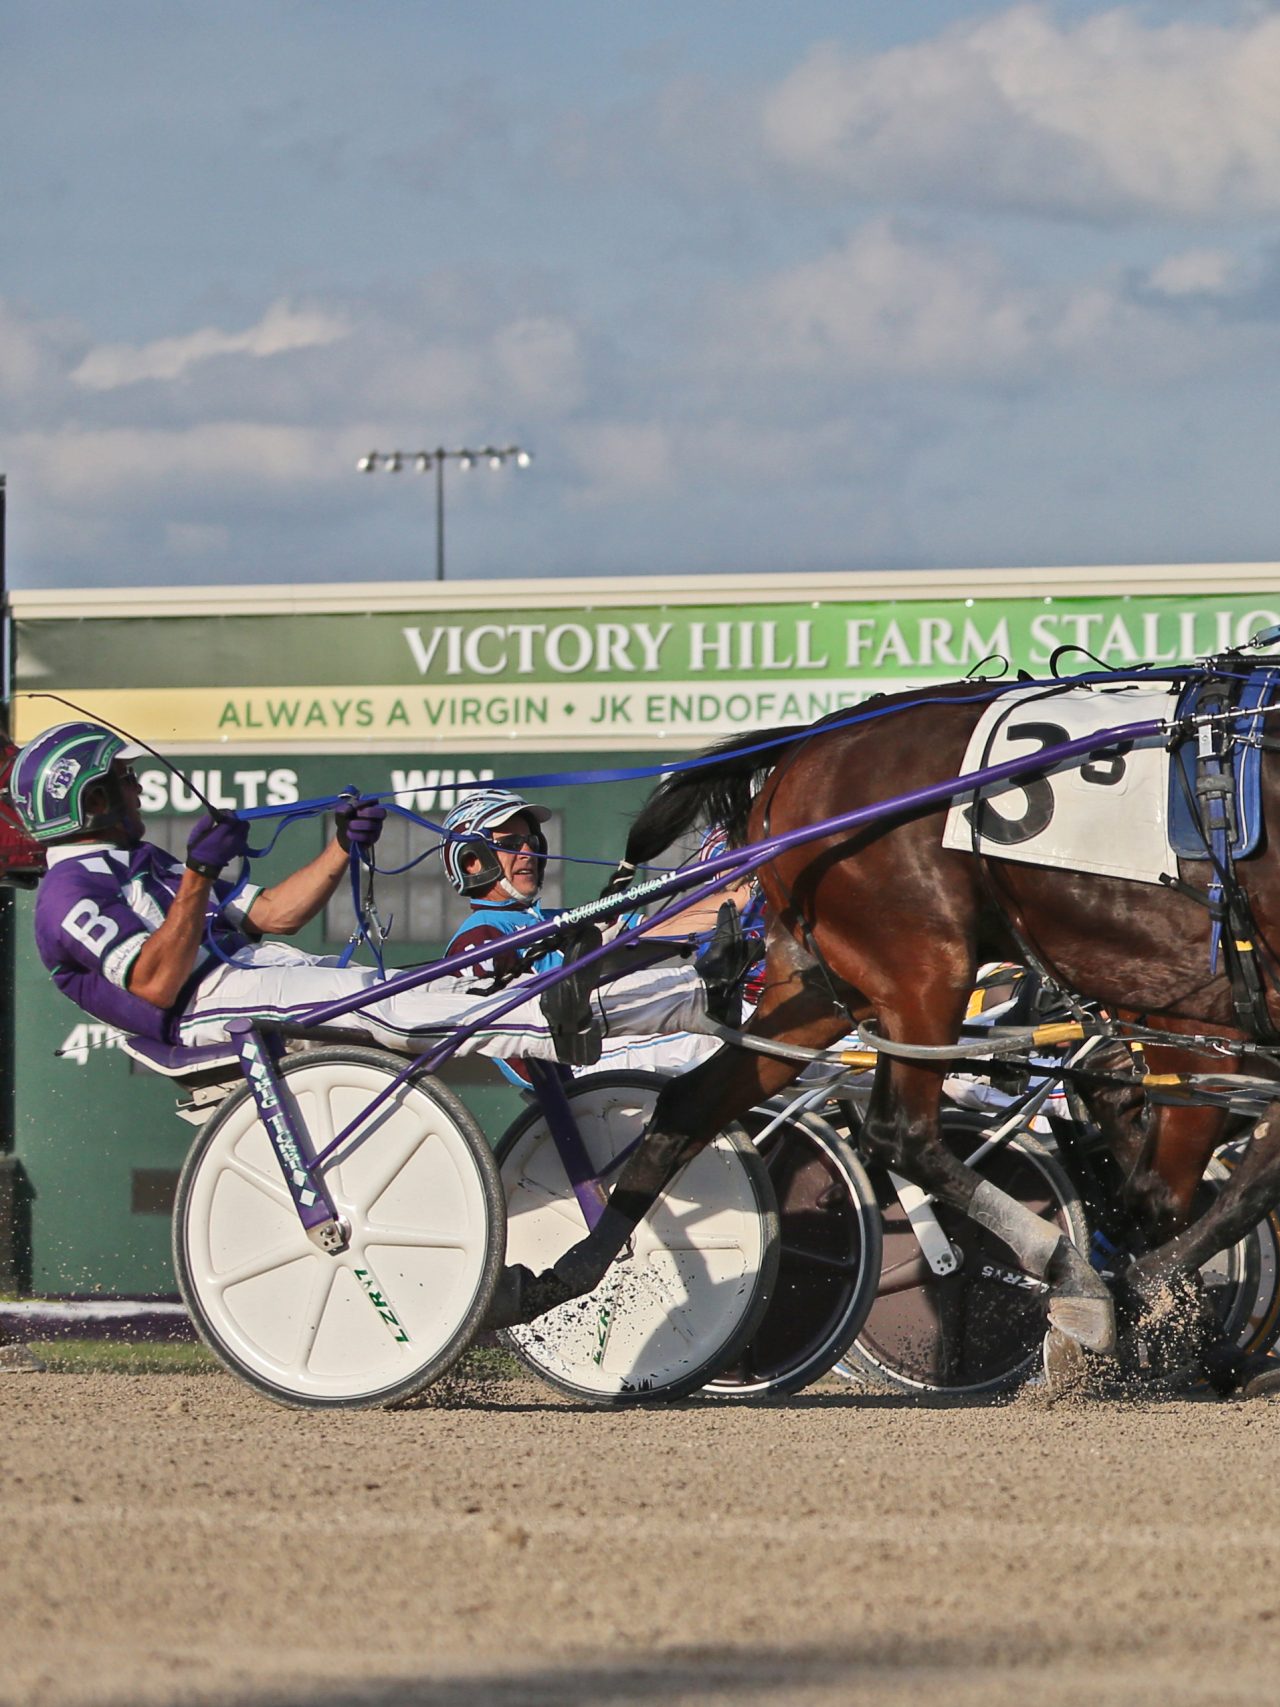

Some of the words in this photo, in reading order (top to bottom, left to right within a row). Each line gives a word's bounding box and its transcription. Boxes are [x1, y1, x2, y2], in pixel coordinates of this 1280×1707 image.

[403, 622, 674, 675] VICTORY
[688, 619, 828, 671] HILL
[845, 616, 1011, 667] FARM
[218, 699, 375, 728] ALWAYS
[386, 698, 411, 727] A
[424, 696, 548, 726] VIRGIN
[590, 695, 633, 723] JK
[138, 769, 299, 812] SULTS
[963, 722, 1071, 845] 3
[61, 898, 119, 958] B
[60, 1023, 128, 1066] 4TH
